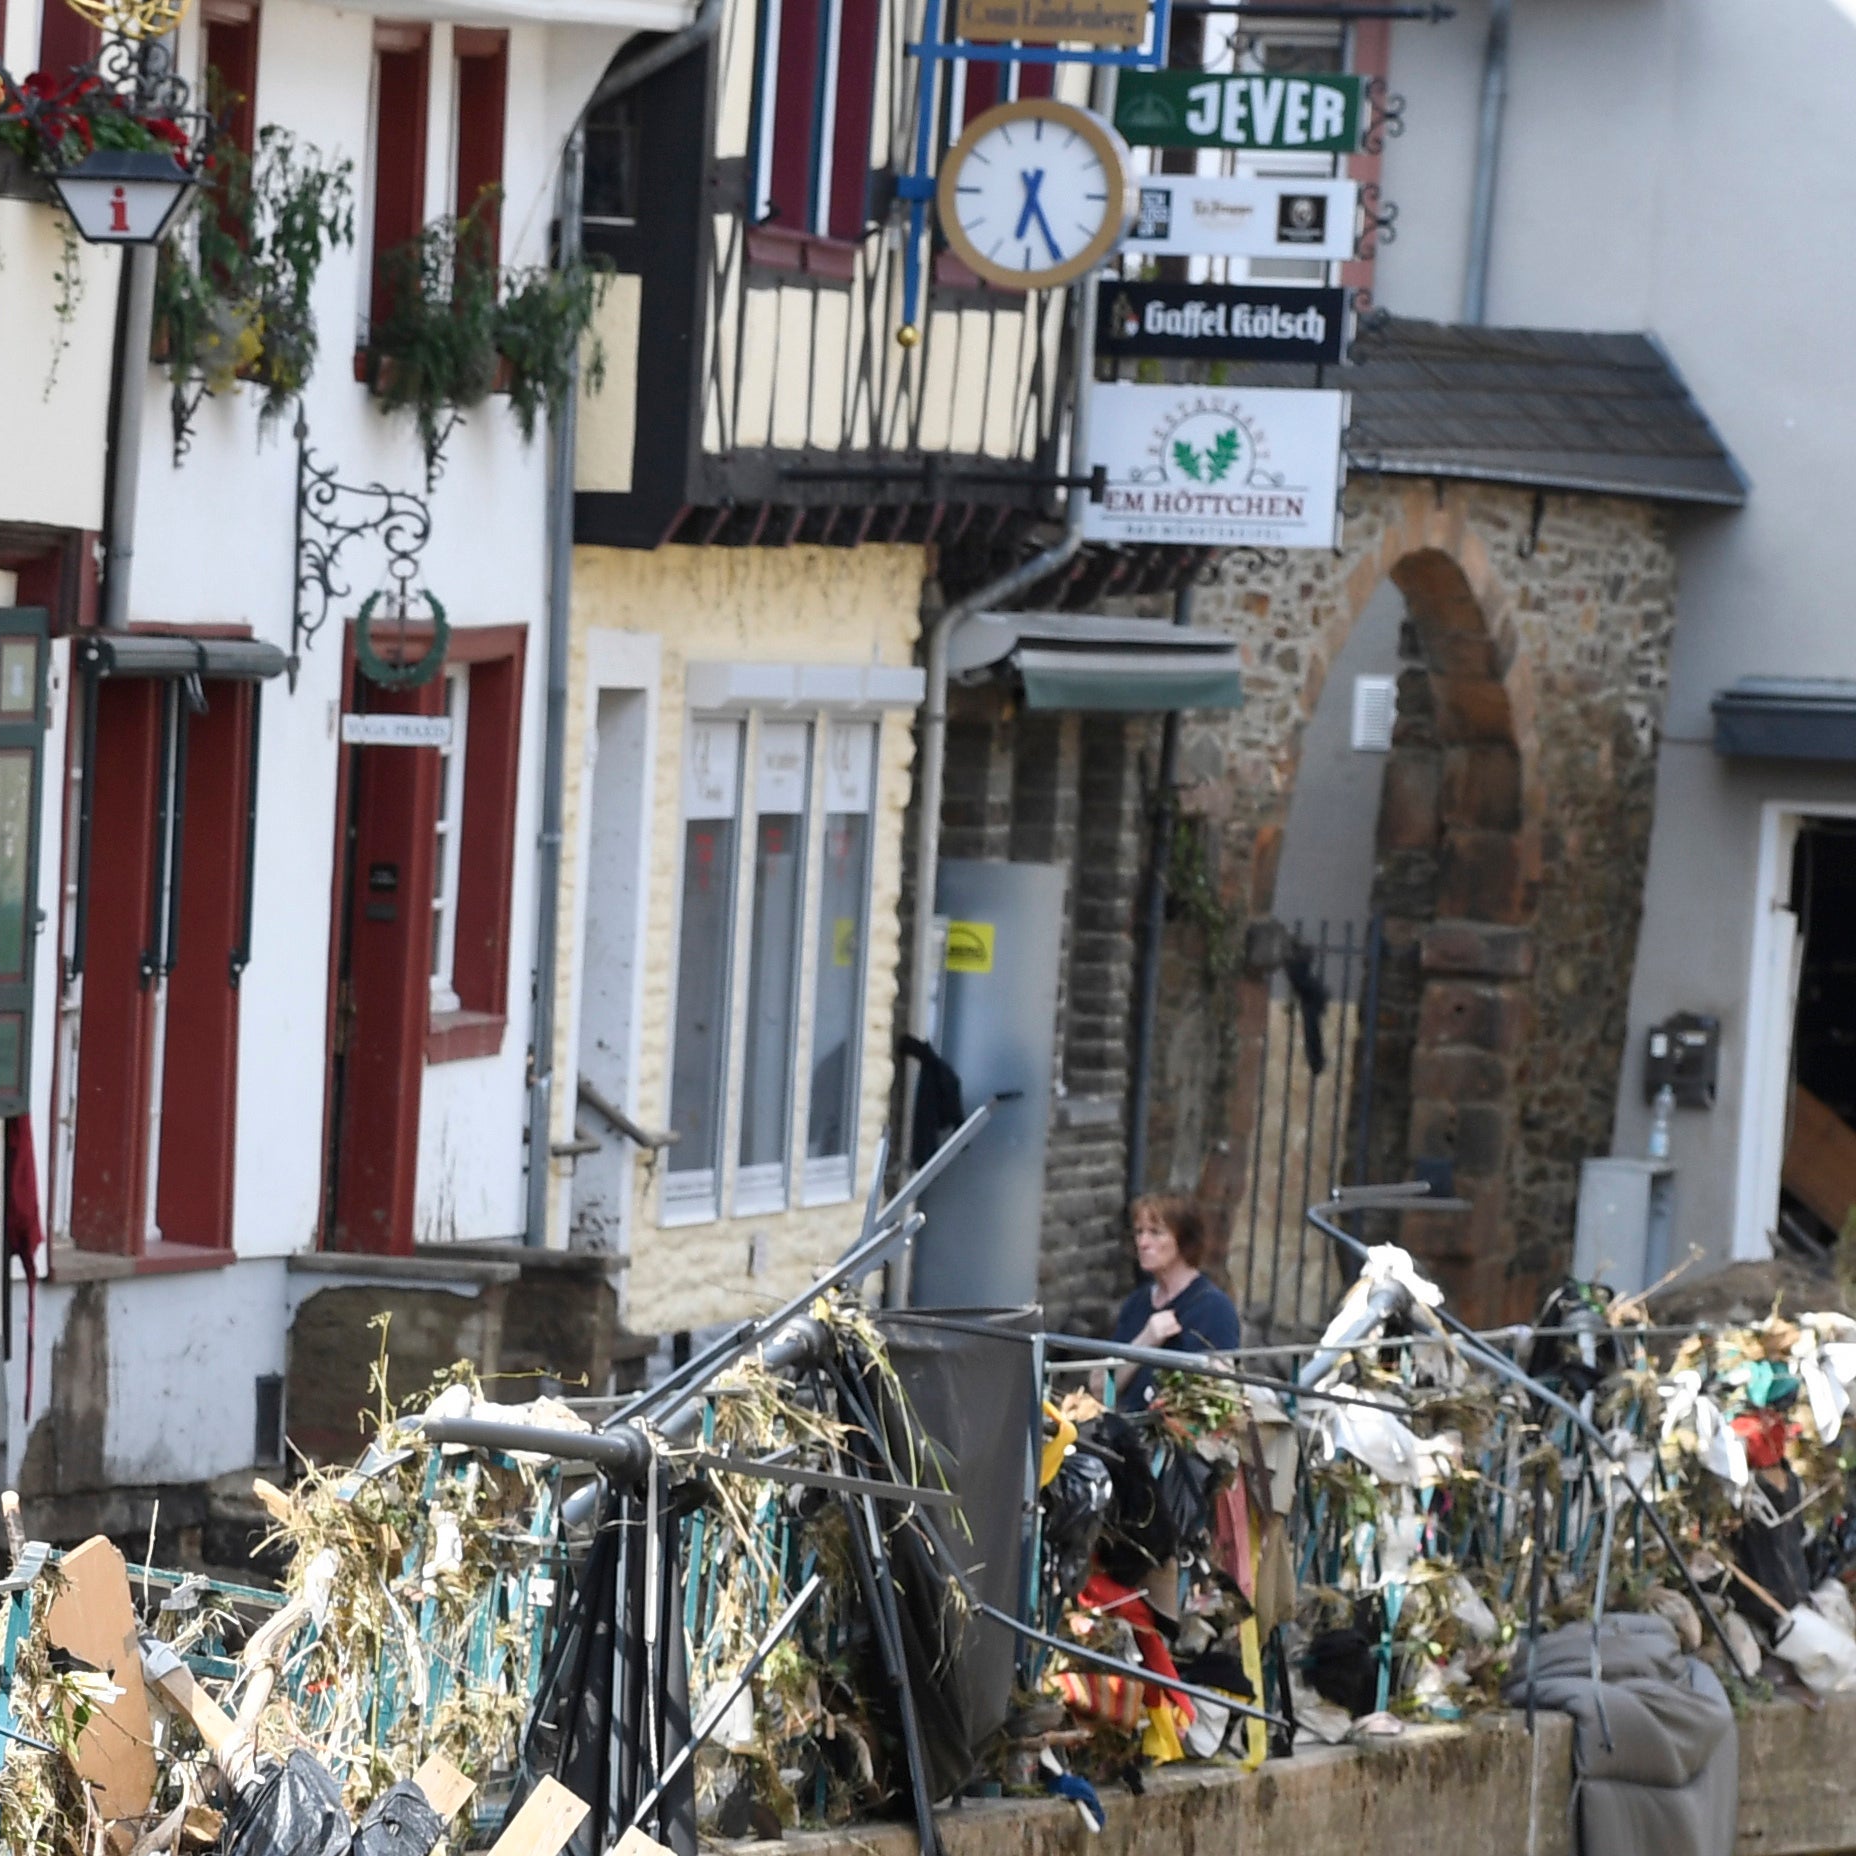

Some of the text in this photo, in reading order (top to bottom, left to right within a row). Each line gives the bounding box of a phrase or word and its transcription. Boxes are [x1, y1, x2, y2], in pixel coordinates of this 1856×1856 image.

[1185, 77, 1347, 146] JEVER
[1144, 300, 1326, 345] Gaffel Kölsch
[1153, 489, 1304, 518] HÖTTCHEN
